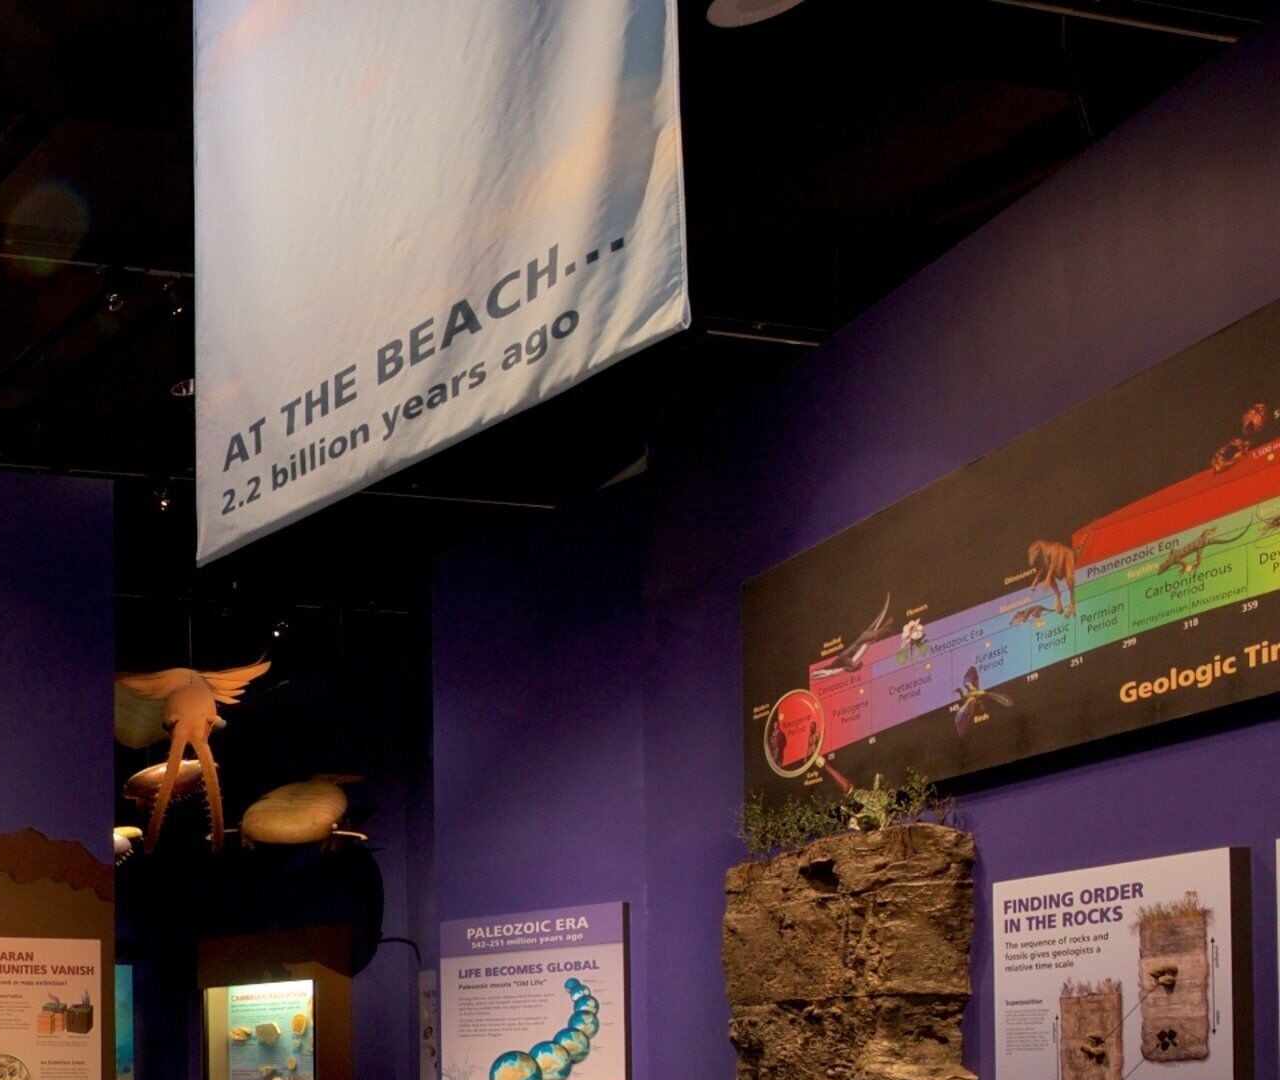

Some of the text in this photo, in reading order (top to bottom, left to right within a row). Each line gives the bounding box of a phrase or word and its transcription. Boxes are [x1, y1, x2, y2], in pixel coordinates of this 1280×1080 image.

[220, 309, 580, 517] 2.2 billion years ago
[223, 418, 267, 473] AT
[280, 364, 358, 438] THE
[1087, 537, 1180, 578] Phanerozoic Eon
[1145, 563, 1233, 600] Carboniferous
[1170, 583, 1205, 600] Period
[1081, 602, 1125, 625] Permian
[1241, 600, 1259, 613] 359
[1132, 604, 1189, 628] Pennsylvanian
[1183, 617, 1199, 631] 318
[1035, 623, 1070, 642] Triassic
[1087, 618, 1118, 634] Period
[930, 628, 984, 655] Mesozoic Era
[1038, 635, 1067, 651] Period
[975, 644, 1008, 665] Jurassic
[1070, 656, 1084, 668] 251
[978, 658, 1004, 672] Period
[850, 675, 862, 685] Era
[888, 674, 932, 696] Cretaceous
[1119, 655, 1237, 703] Geologic
[898, 689, 921, 701] Period
[841, 712, 861, 725] Period
[1003, 882, 1144, 915] FINDING ORDER
[466, 916, 589, 940] PALEOZOIC ERA
[1004, 906, 1123, 934] IN THE ROCKS
[506, 933, 584, 946] million years ago
[1005, 932, 1109, 950] The sequence of rocks and
[1004, 952, 1028, 961] fossils
[1030, 950, 1050, 961] gives
[1051, 947, 1094, 959] geologists
[50, 965, 95, 976] VANISH
[458, 959, 600, 979] LIFE BECOMES GLOBAL
[1005, 960, 1075, 973] relative time scale
[231, 993, 267, 1001] CAMBRIAN
